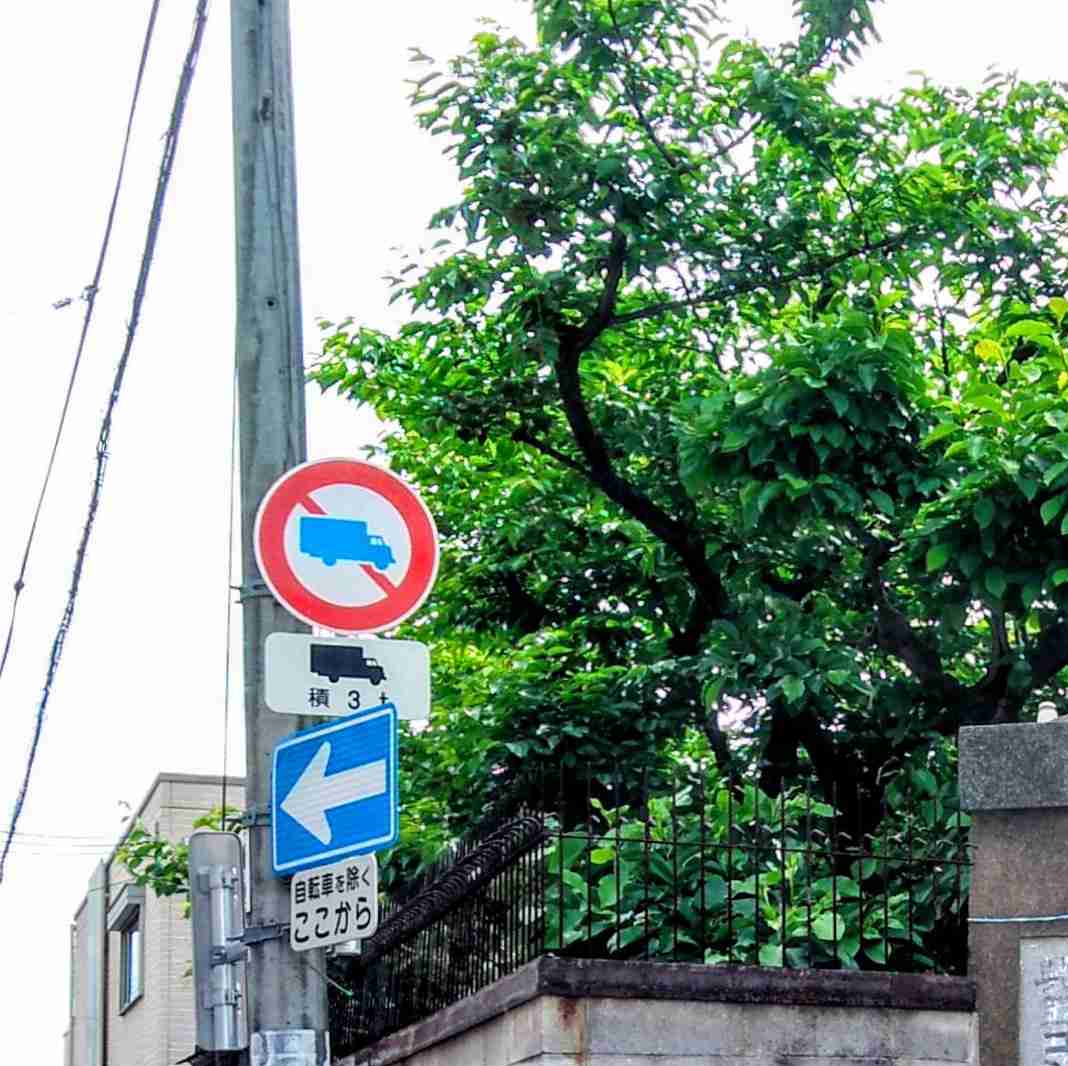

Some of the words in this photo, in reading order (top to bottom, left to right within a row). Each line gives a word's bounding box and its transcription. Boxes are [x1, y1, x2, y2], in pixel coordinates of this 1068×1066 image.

[295, 865, 371, 905] 自転車を除く
[294, 896, 372, 943] ここから
